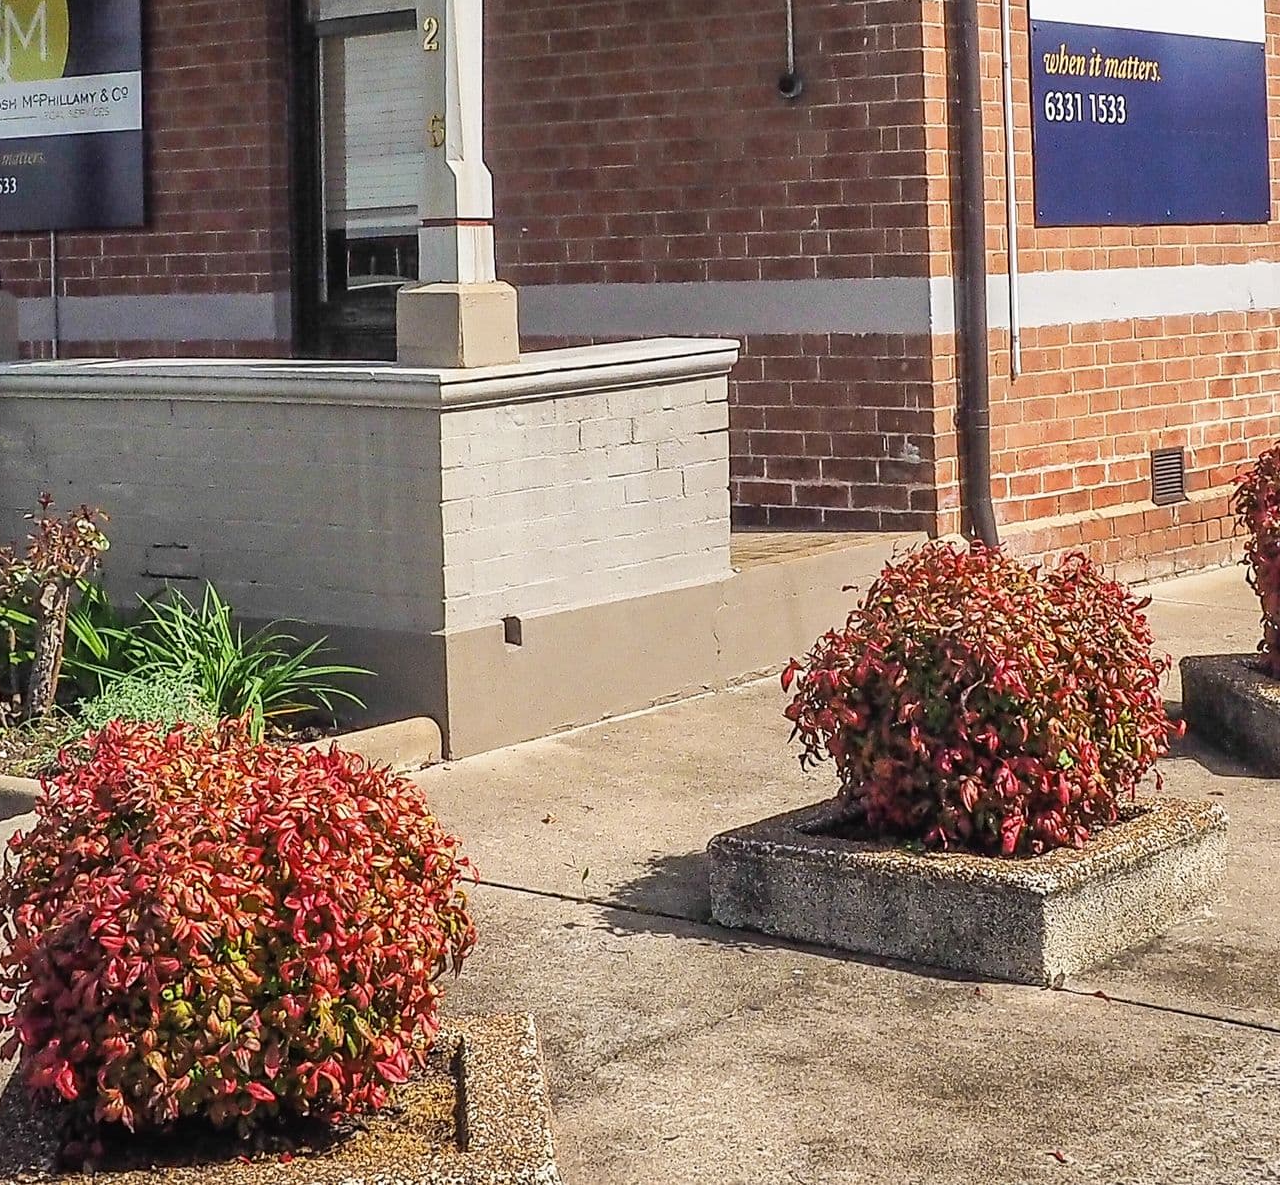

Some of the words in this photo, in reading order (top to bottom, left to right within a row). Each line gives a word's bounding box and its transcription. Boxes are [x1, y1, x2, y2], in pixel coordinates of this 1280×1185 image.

[1043, 43, 1086, 76] when
[1089, 47, 1102, 77] it
[1104, 55, 1161, 82] matters.
[99, 87, 109, 103] &
[1044, 91, 1083, 122] 6331
[1089, 93, 1126, 124] 1533
